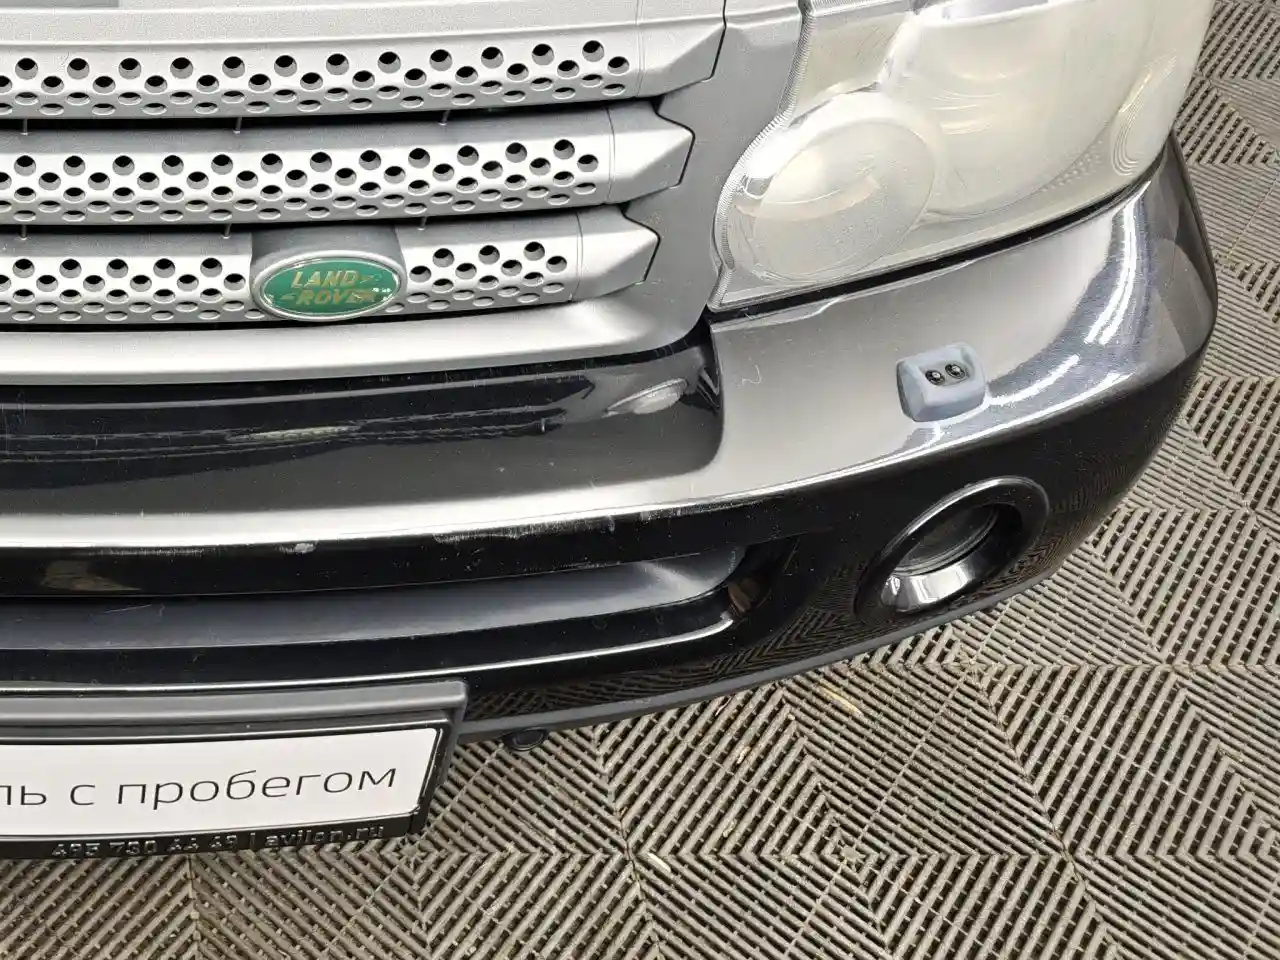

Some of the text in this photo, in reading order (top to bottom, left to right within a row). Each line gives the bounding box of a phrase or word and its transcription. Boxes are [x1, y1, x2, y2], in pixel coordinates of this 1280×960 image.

[291, 270, 358, 288] LAND
[296, 288, 376, 305] ROVER
[69, 783, 97, 807] с
[117, 767, 397, 811] пробегом
